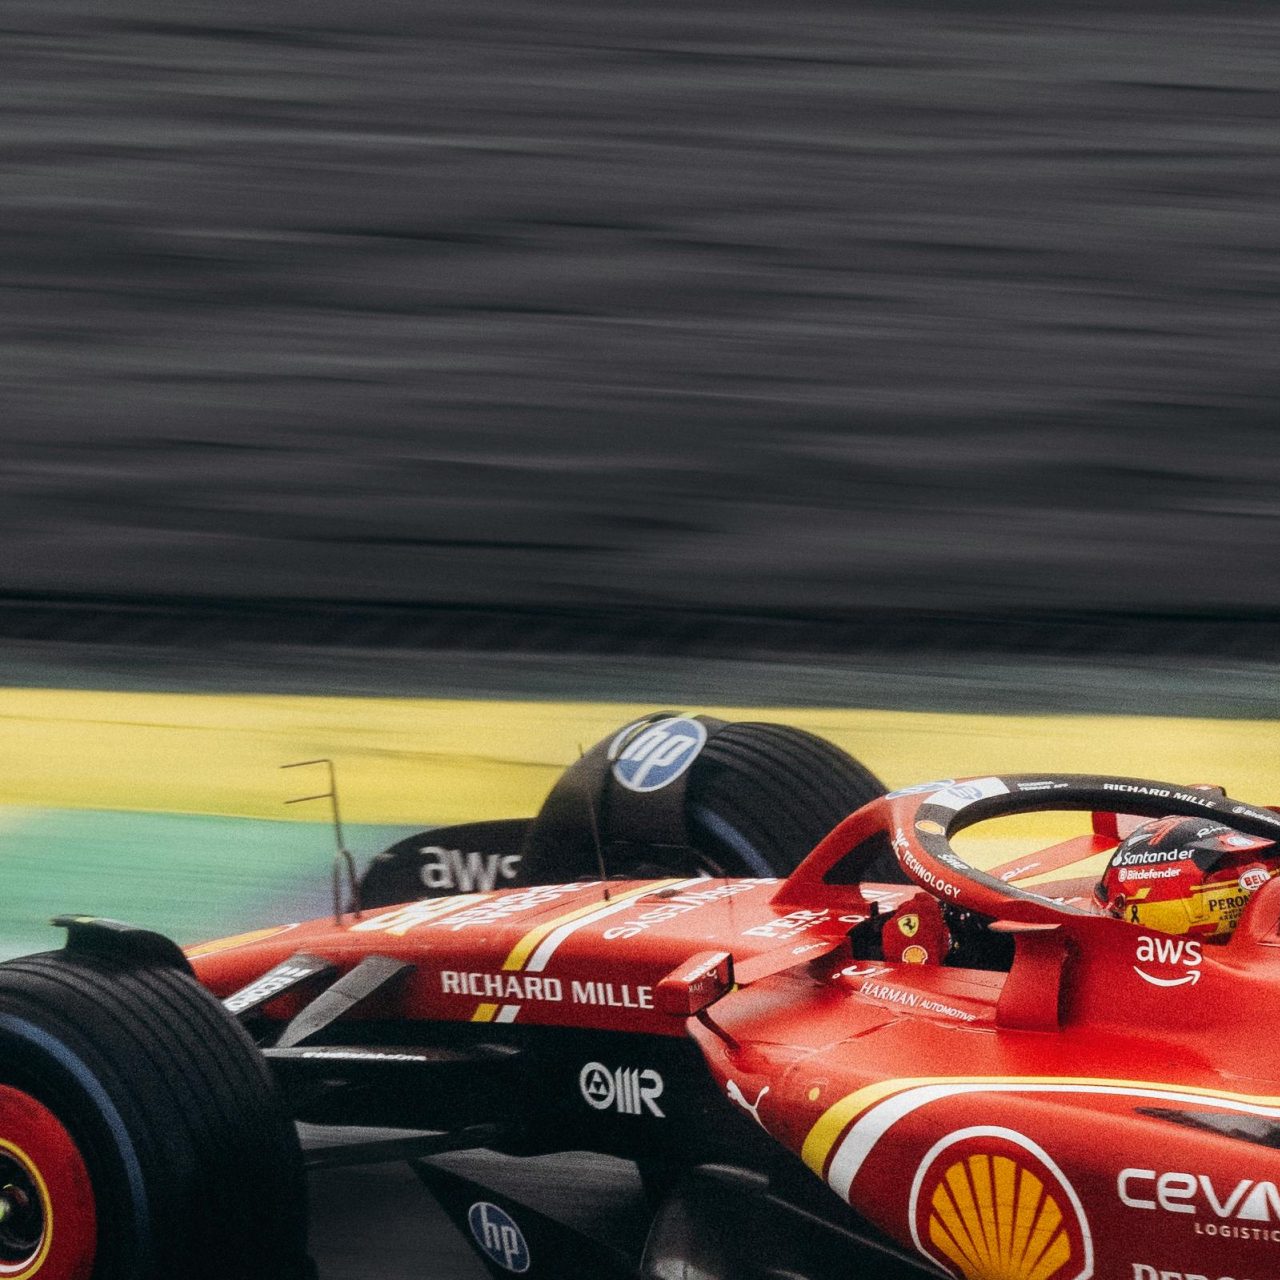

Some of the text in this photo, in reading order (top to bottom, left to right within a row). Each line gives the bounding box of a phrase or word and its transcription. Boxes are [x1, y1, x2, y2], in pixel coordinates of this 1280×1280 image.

[618, 719, 703, 790] hp
[1103, 783, 1217, 809] RICHARD MILLE
[902, 850, 961, 899] TECHNOLOGY
[1121, 848, 1195, 866] Santander
[1126, 868, 1181, 881] Bitdefender
[1208, 895, 1250, 912] PERON
[1136, 935, 1203, 966] aws
[440, 970, 655, 1009] RICHARD MILLE
[859, 981, 977, 1022] HARMAN AUTOMOTIVE
[476, 1202, 525, 1271] hp
